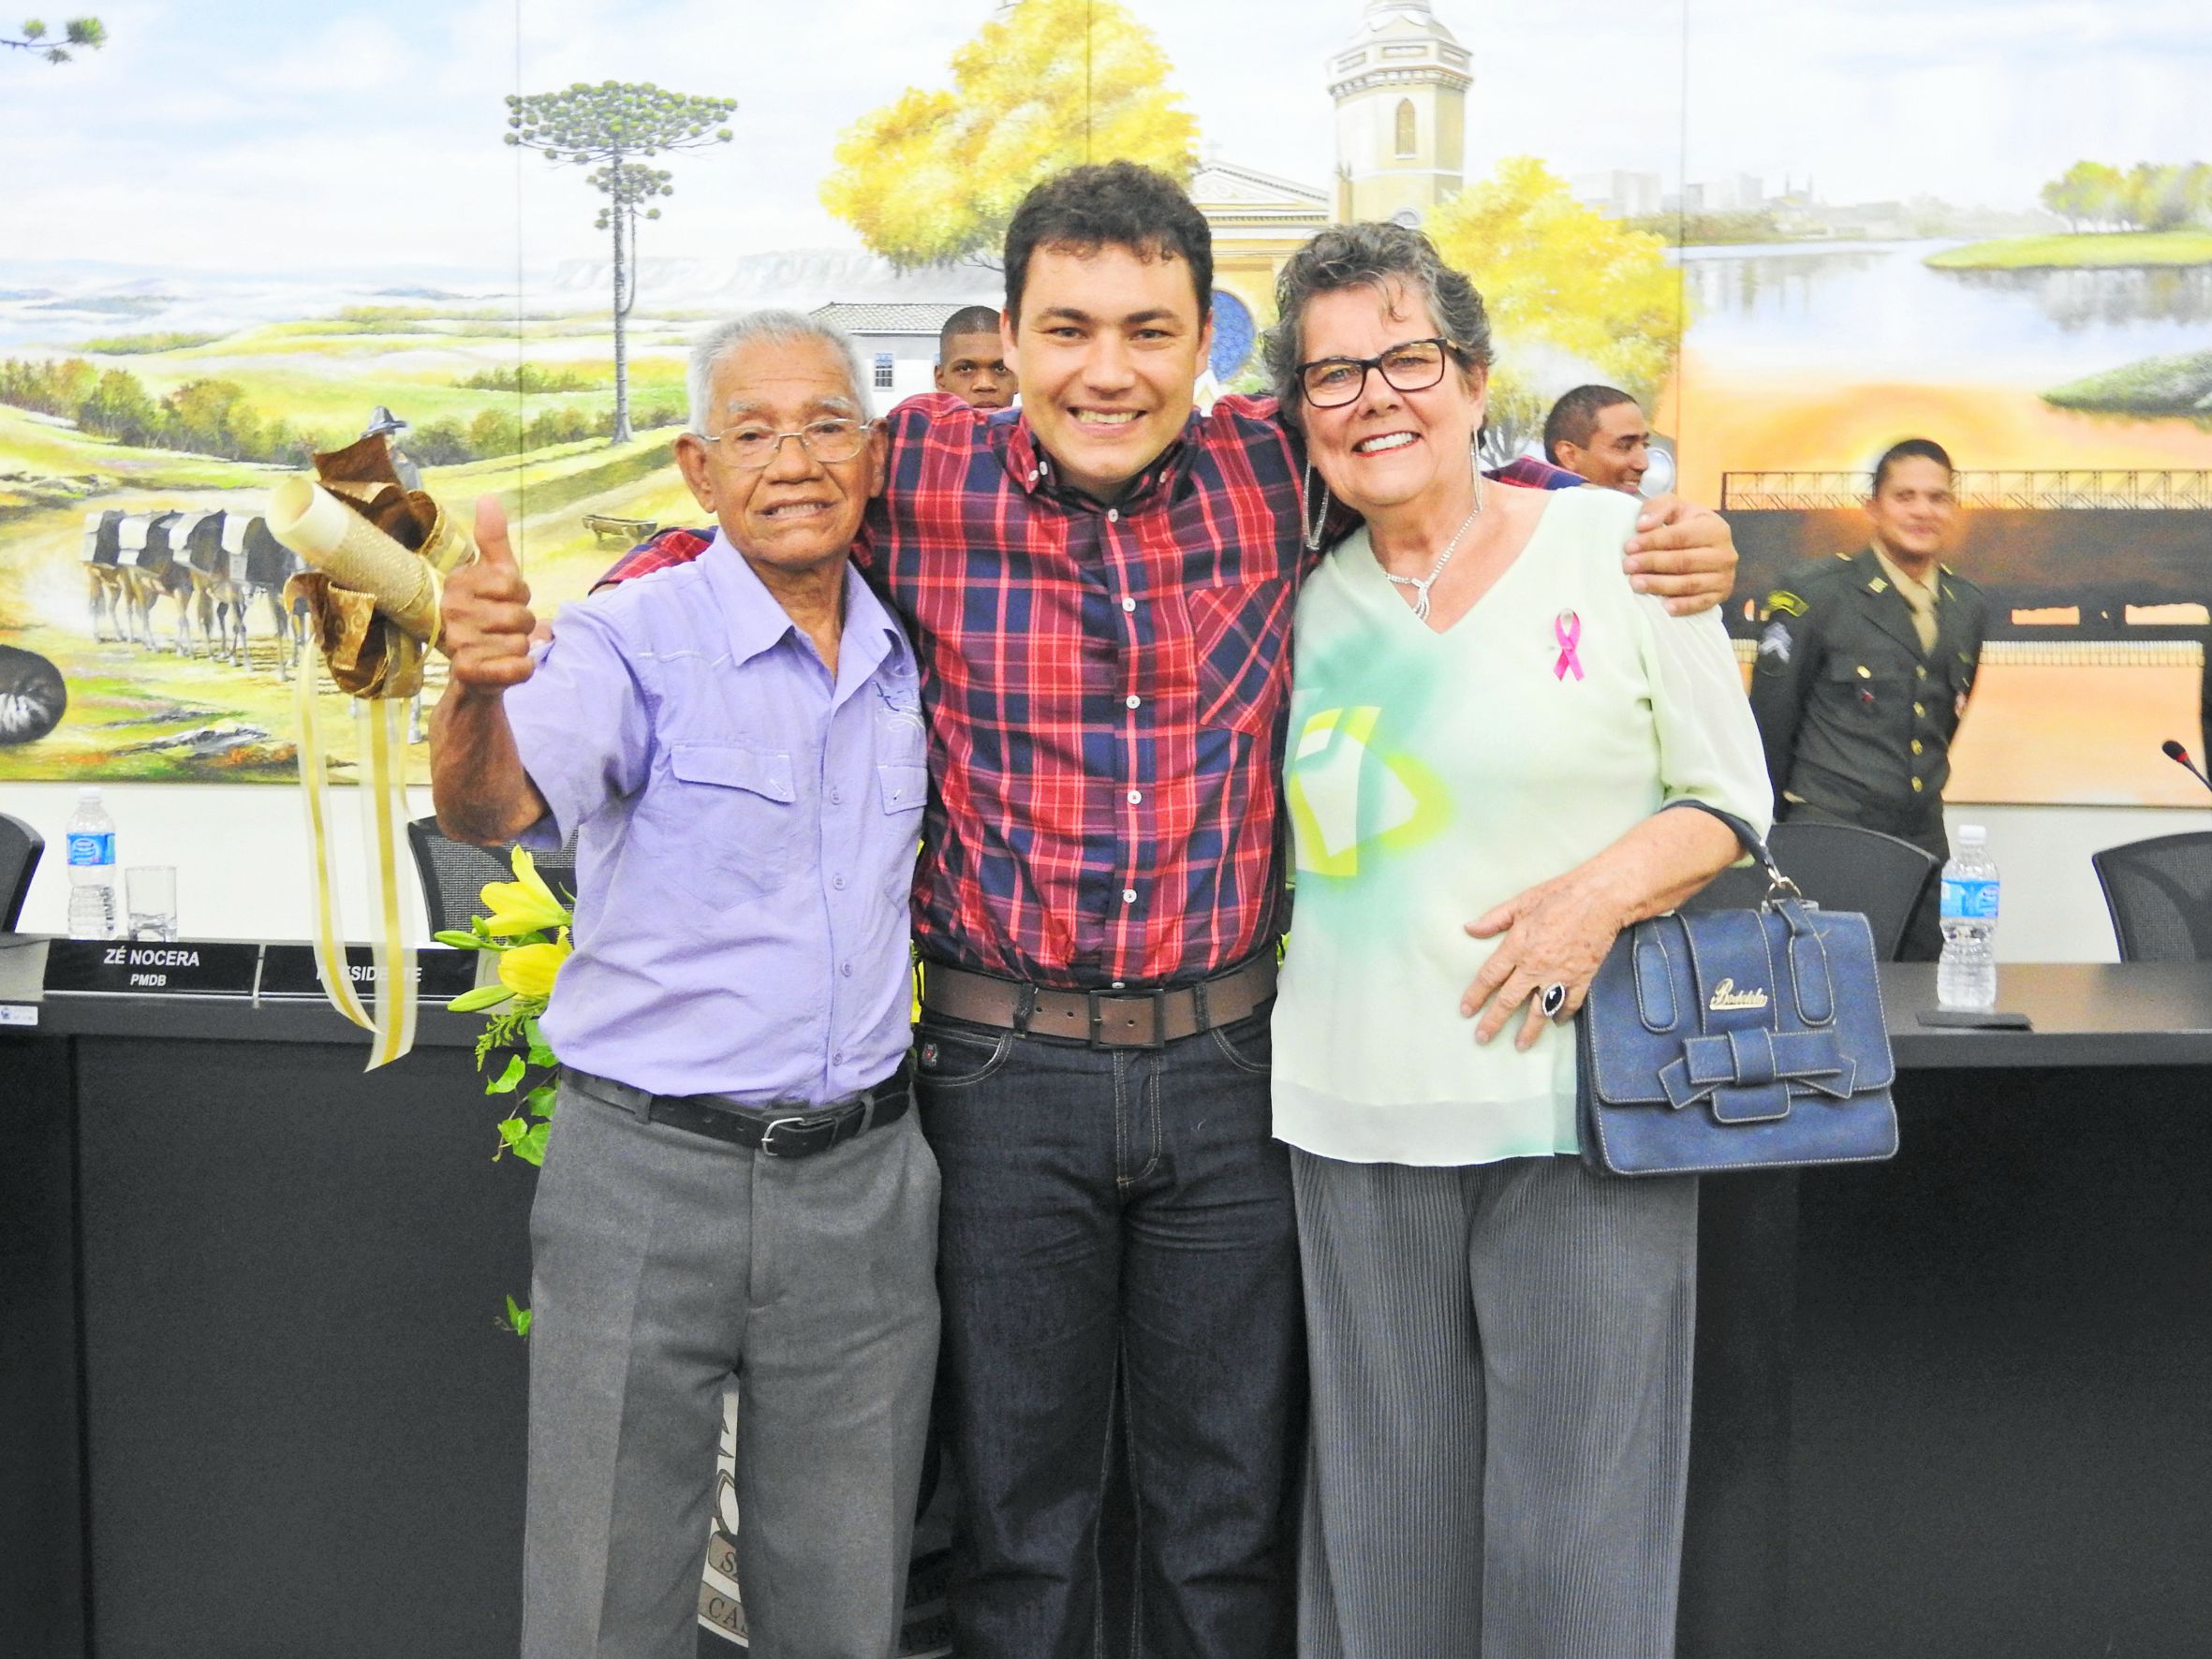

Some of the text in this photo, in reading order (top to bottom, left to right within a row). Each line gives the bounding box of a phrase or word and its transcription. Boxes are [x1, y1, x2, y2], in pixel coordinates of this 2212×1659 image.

[103, 946, 200, 967] ZÉ NOCERA
[129, 973, 167, 987] PMDB
[315, 964, 423, 983] SIDETE
[709, 1596, 748, 1637] CA
